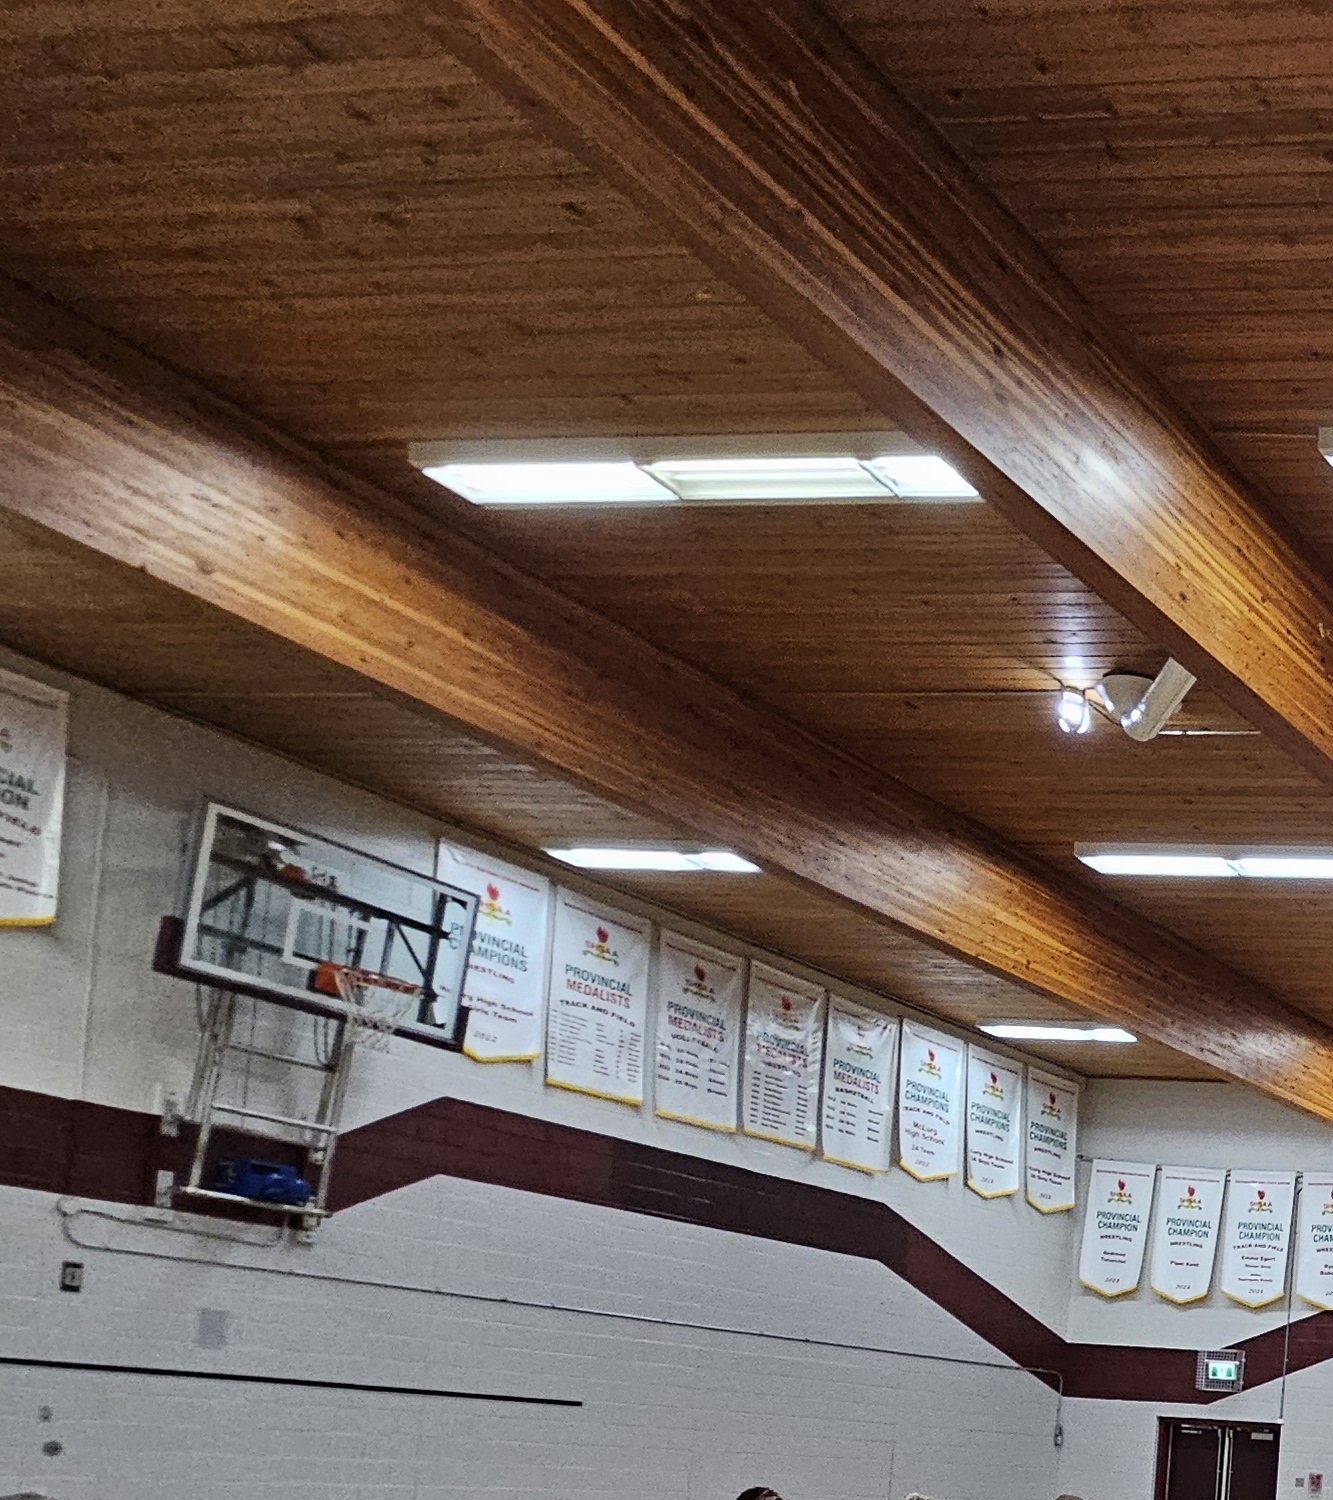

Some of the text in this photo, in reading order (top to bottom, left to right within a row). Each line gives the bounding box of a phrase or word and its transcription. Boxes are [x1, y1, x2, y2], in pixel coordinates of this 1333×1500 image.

[450, 922, 528, 958] PVINCIAL
[450, 937, 528, 973] CAMPIONS
[468, 964, 515, 984] RESTLING
[565, 964, 633, 997] PROVINCIAL
[566, 978, 630, 1009] MEDALISTS
[559, 999, 635, 1028] TRACK AND FIELD
[667, 1001, 726, 1031] PROVINCIAL
[668, 1015, 725, 1043] MEDALISTS
[833, 1058, 881, 1084] PROVINCIAL
[833, 1070, 879, 1094] MEDALISTS
[835, 1087, 874, 1104] BASKETBALL
[905, 1090, 949, 1113] CHAMPIONS
[906, 1079, 950, 1103] PROVINCIAL
[970, 1112, 1010, 1132] CHAMPIONS
[971, 1101, 1010, 1123] PROVINCIAL
[1029, 1131, 1067, 1150] CHAMPIONS
[1031, 1121, 1068, 1140] PROVINCIAL
[1096, 1210, 1141, 1223] PROVINCIAL
[1098, 1220, 1138, 1232] CHAMPION
[1166, 1217, 1212, 1229] PROVINCIAL
[1238, 1222, 1284, 1232] PROVINCIAL
[1168, 1227, 1209, 1238] CHAMPION
[1239, 1231, 1280, 1241] CHAMPION
